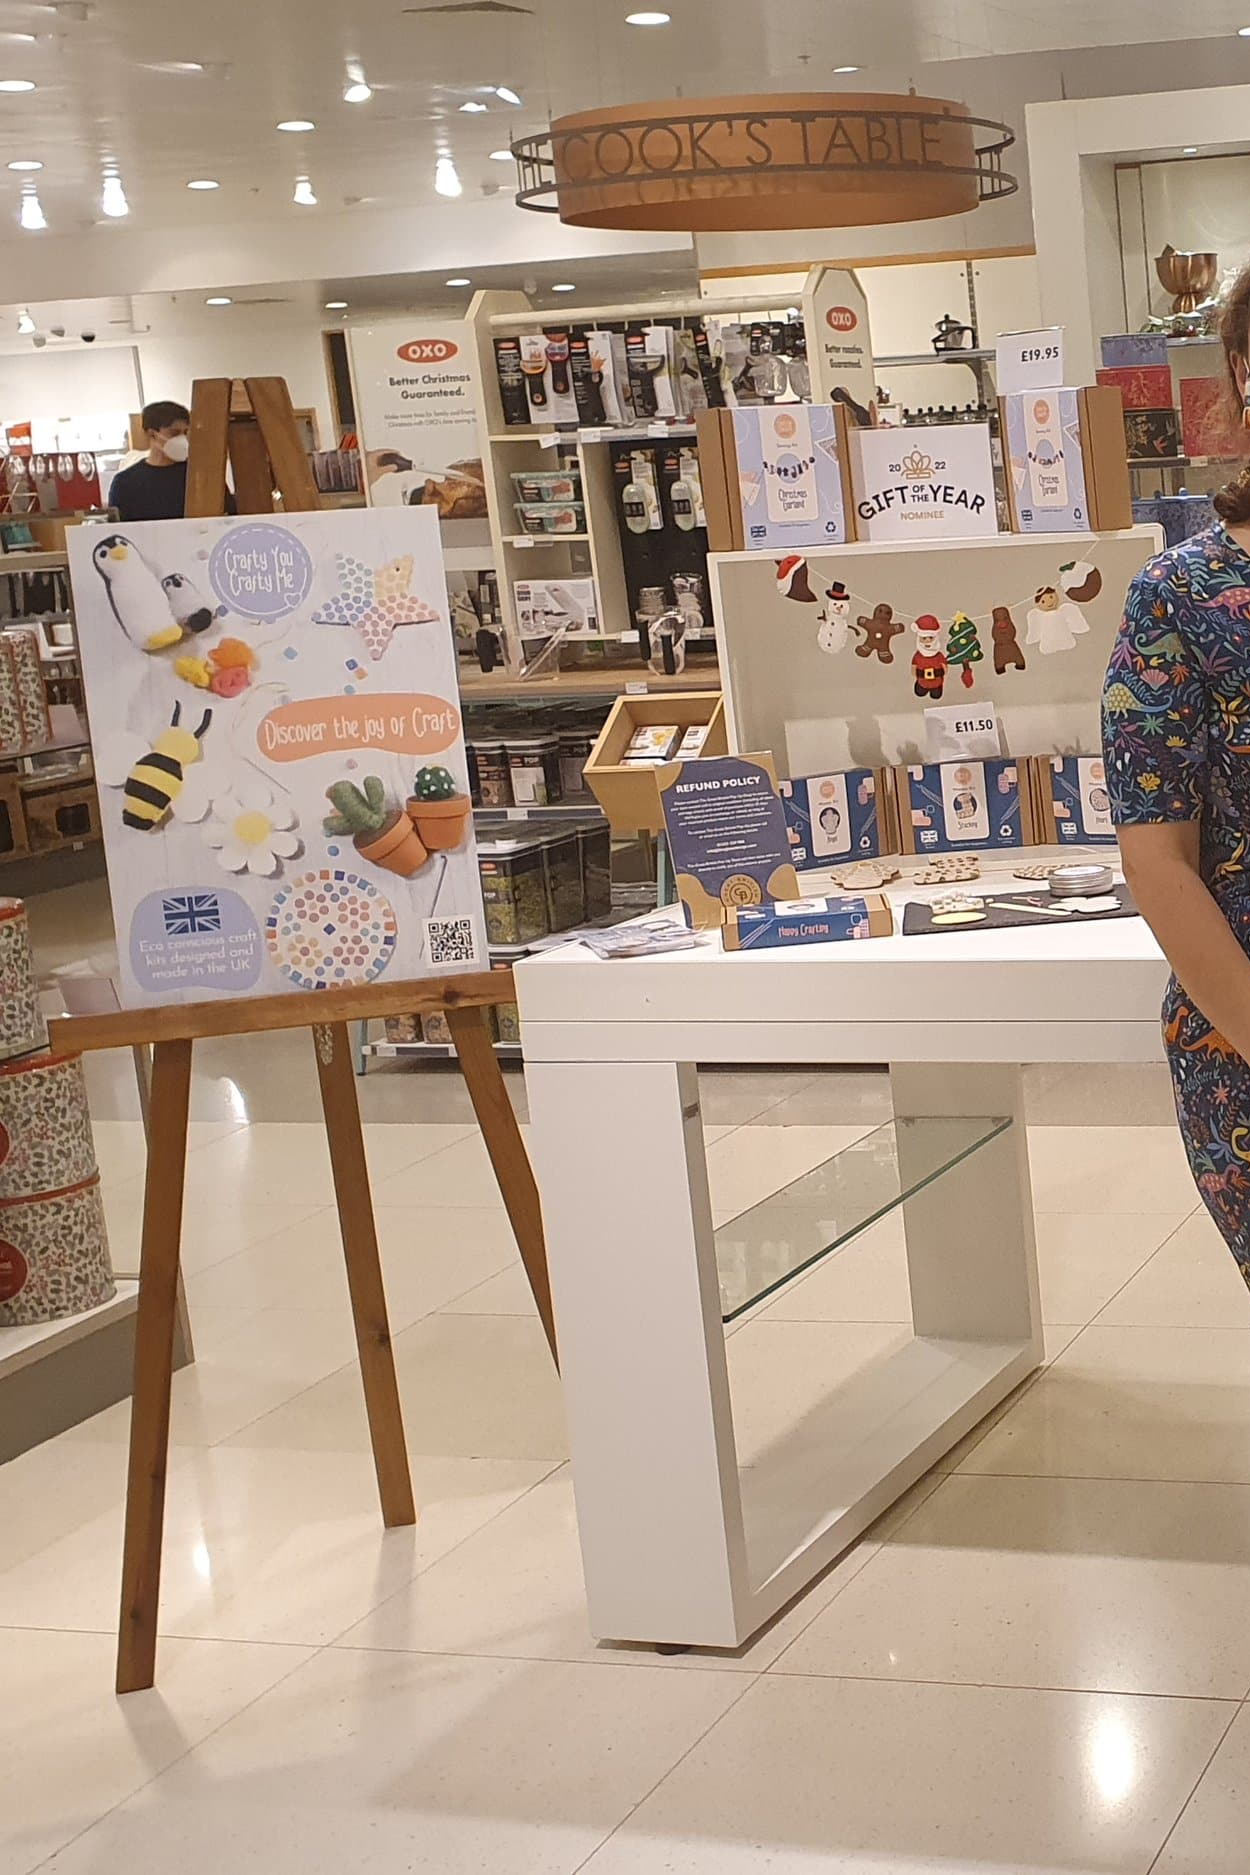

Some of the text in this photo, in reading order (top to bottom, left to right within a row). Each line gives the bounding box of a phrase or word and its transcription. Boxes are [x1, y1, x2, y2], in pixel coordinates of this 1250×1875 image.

[562, 119, 772, 183] COOK'S
[792, 115, 944, 166] TABLE
[831, 311, 852, 326] OXO
[407, 343, 447, 359] OXO
[1021, 346, 1059, 362] £19.95
[389, 373, 471, 387] Better Christmas
[401, 387, 465, 400] Guaranteed.
[889, 463, 901, 473] 20
[934, 461, 946, 470] 22
[912, 484, 925, 493] OF
[857, 485, 909, 521] GIFT
[911, 492, 929, 503] THE
[928, 484, 986, 515] YEAR
[900, 510, 945, 521] NOMINEE
[224, 545, 295, 573] Crafty You
[230, 567, 295, 597] Crafty Me
[264, 707, 457, 750] Discover the joy of Craft
[955, 719, 993, 733] £11.50
[676, 775, 761, 794] REFUND POLICY
[139, 930, 257, 953] Eco conscious craft
[146, 944, 254, 967] kits designed and
[151, 958, 251, 980] made in the UK
